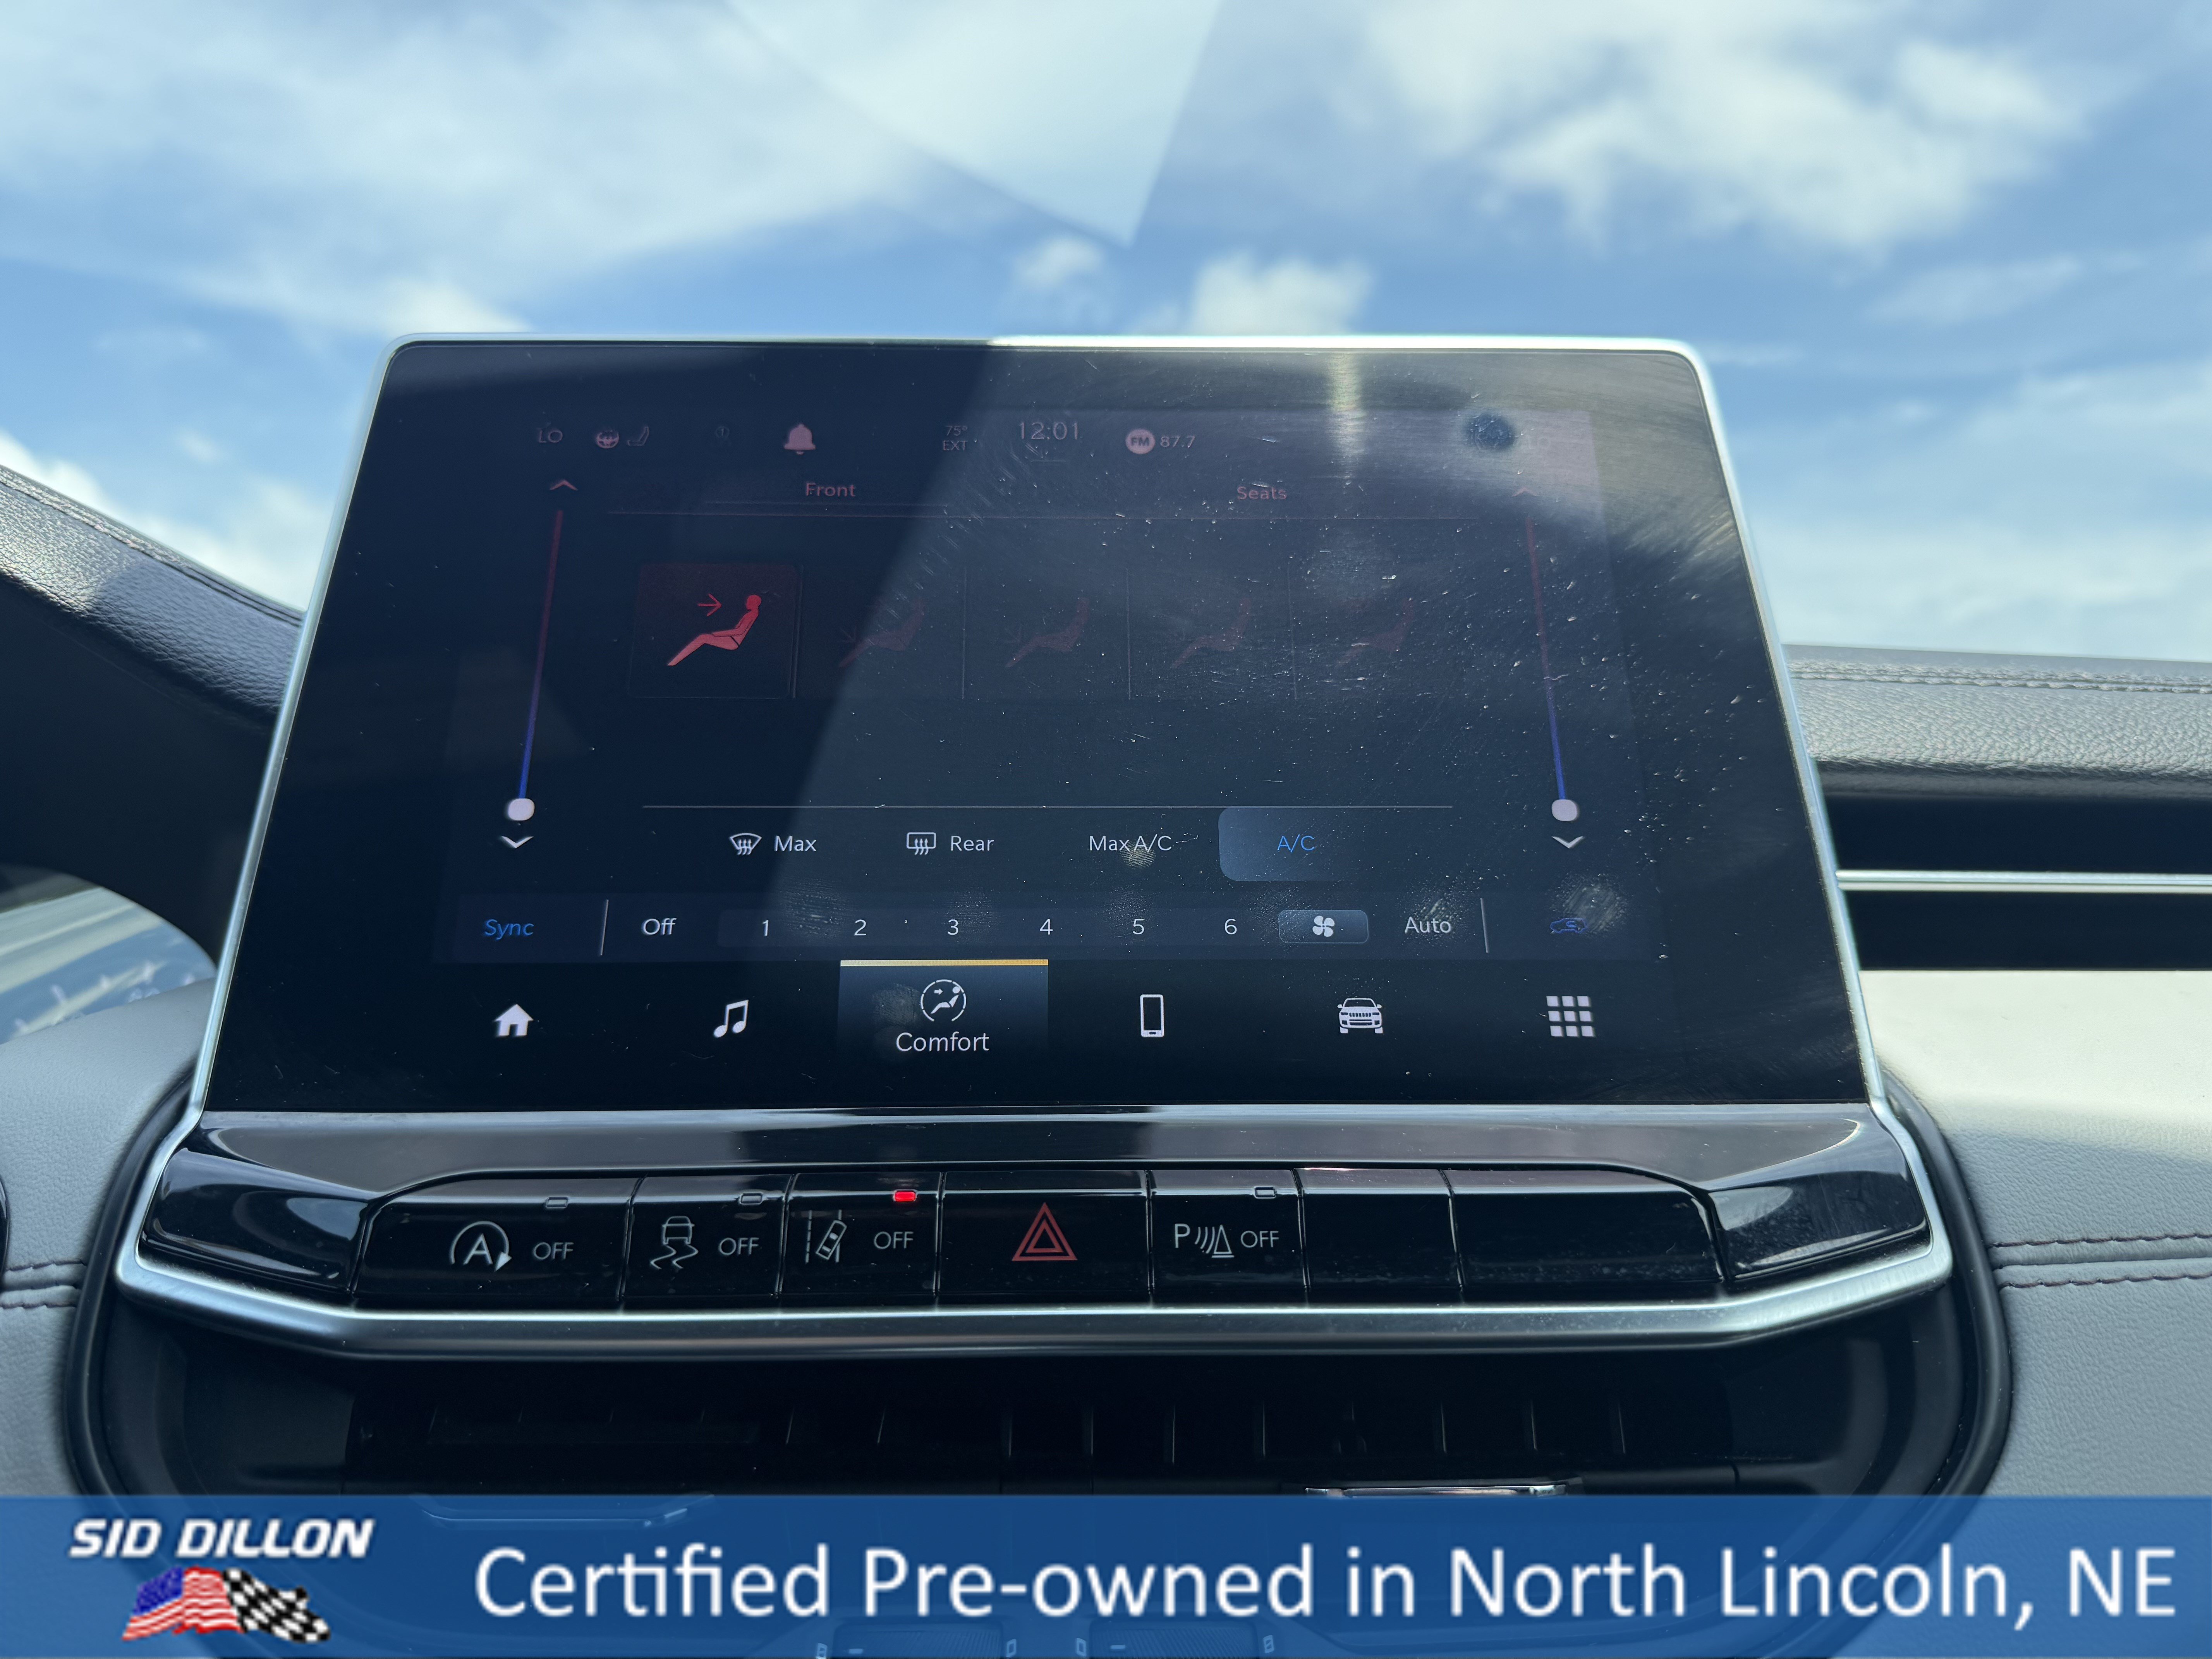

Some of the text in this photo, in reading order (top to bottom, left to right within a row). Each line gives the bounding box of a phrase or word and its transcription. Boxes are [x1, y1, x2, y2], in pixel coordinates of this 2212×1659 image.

[538, 429, 563, 443] LO
[1018, 421, 1080, 440] 12:01
[942, 440, 969, 451] EXT
[1130, 436, 1150, 447] FM
[1160, 435, 1195, 448] 87.7
[805, 482, 855, 496] Front
[1237, 486, 1287, 500] Seats
[775, 835, 816, 851] Max
[951, 835, 994, 851] Rear
[1090, 834, 1172, 853] Max A/C
[1277, 834, 1315, 853] A/C
[484, 919, 534, 940] Sync
[642, 918, 677, 935] Off
[762, 919, 769, 936] 1
[854, 919, 866, 936] 2
[947, 919, 959, 935] 3
[1039, 919, 1053, 935] 4
[1133, 918, 1144, 935] 5
[1224, 919, 1237, 935] 6
[1405, 915, 1452, 933] Auto
[896, 1031, 989, 1052] Comfort
[874, 1231, 913, 1249] OFF
[1175, 1223, 1190, 1248] P
[1240, 1230, 1279, 1248] OFF
[464, 1234, 493, 1264] A
[532, 1242, 574, 1260] OFF
[718, 1237, 759, 1256] OFF
